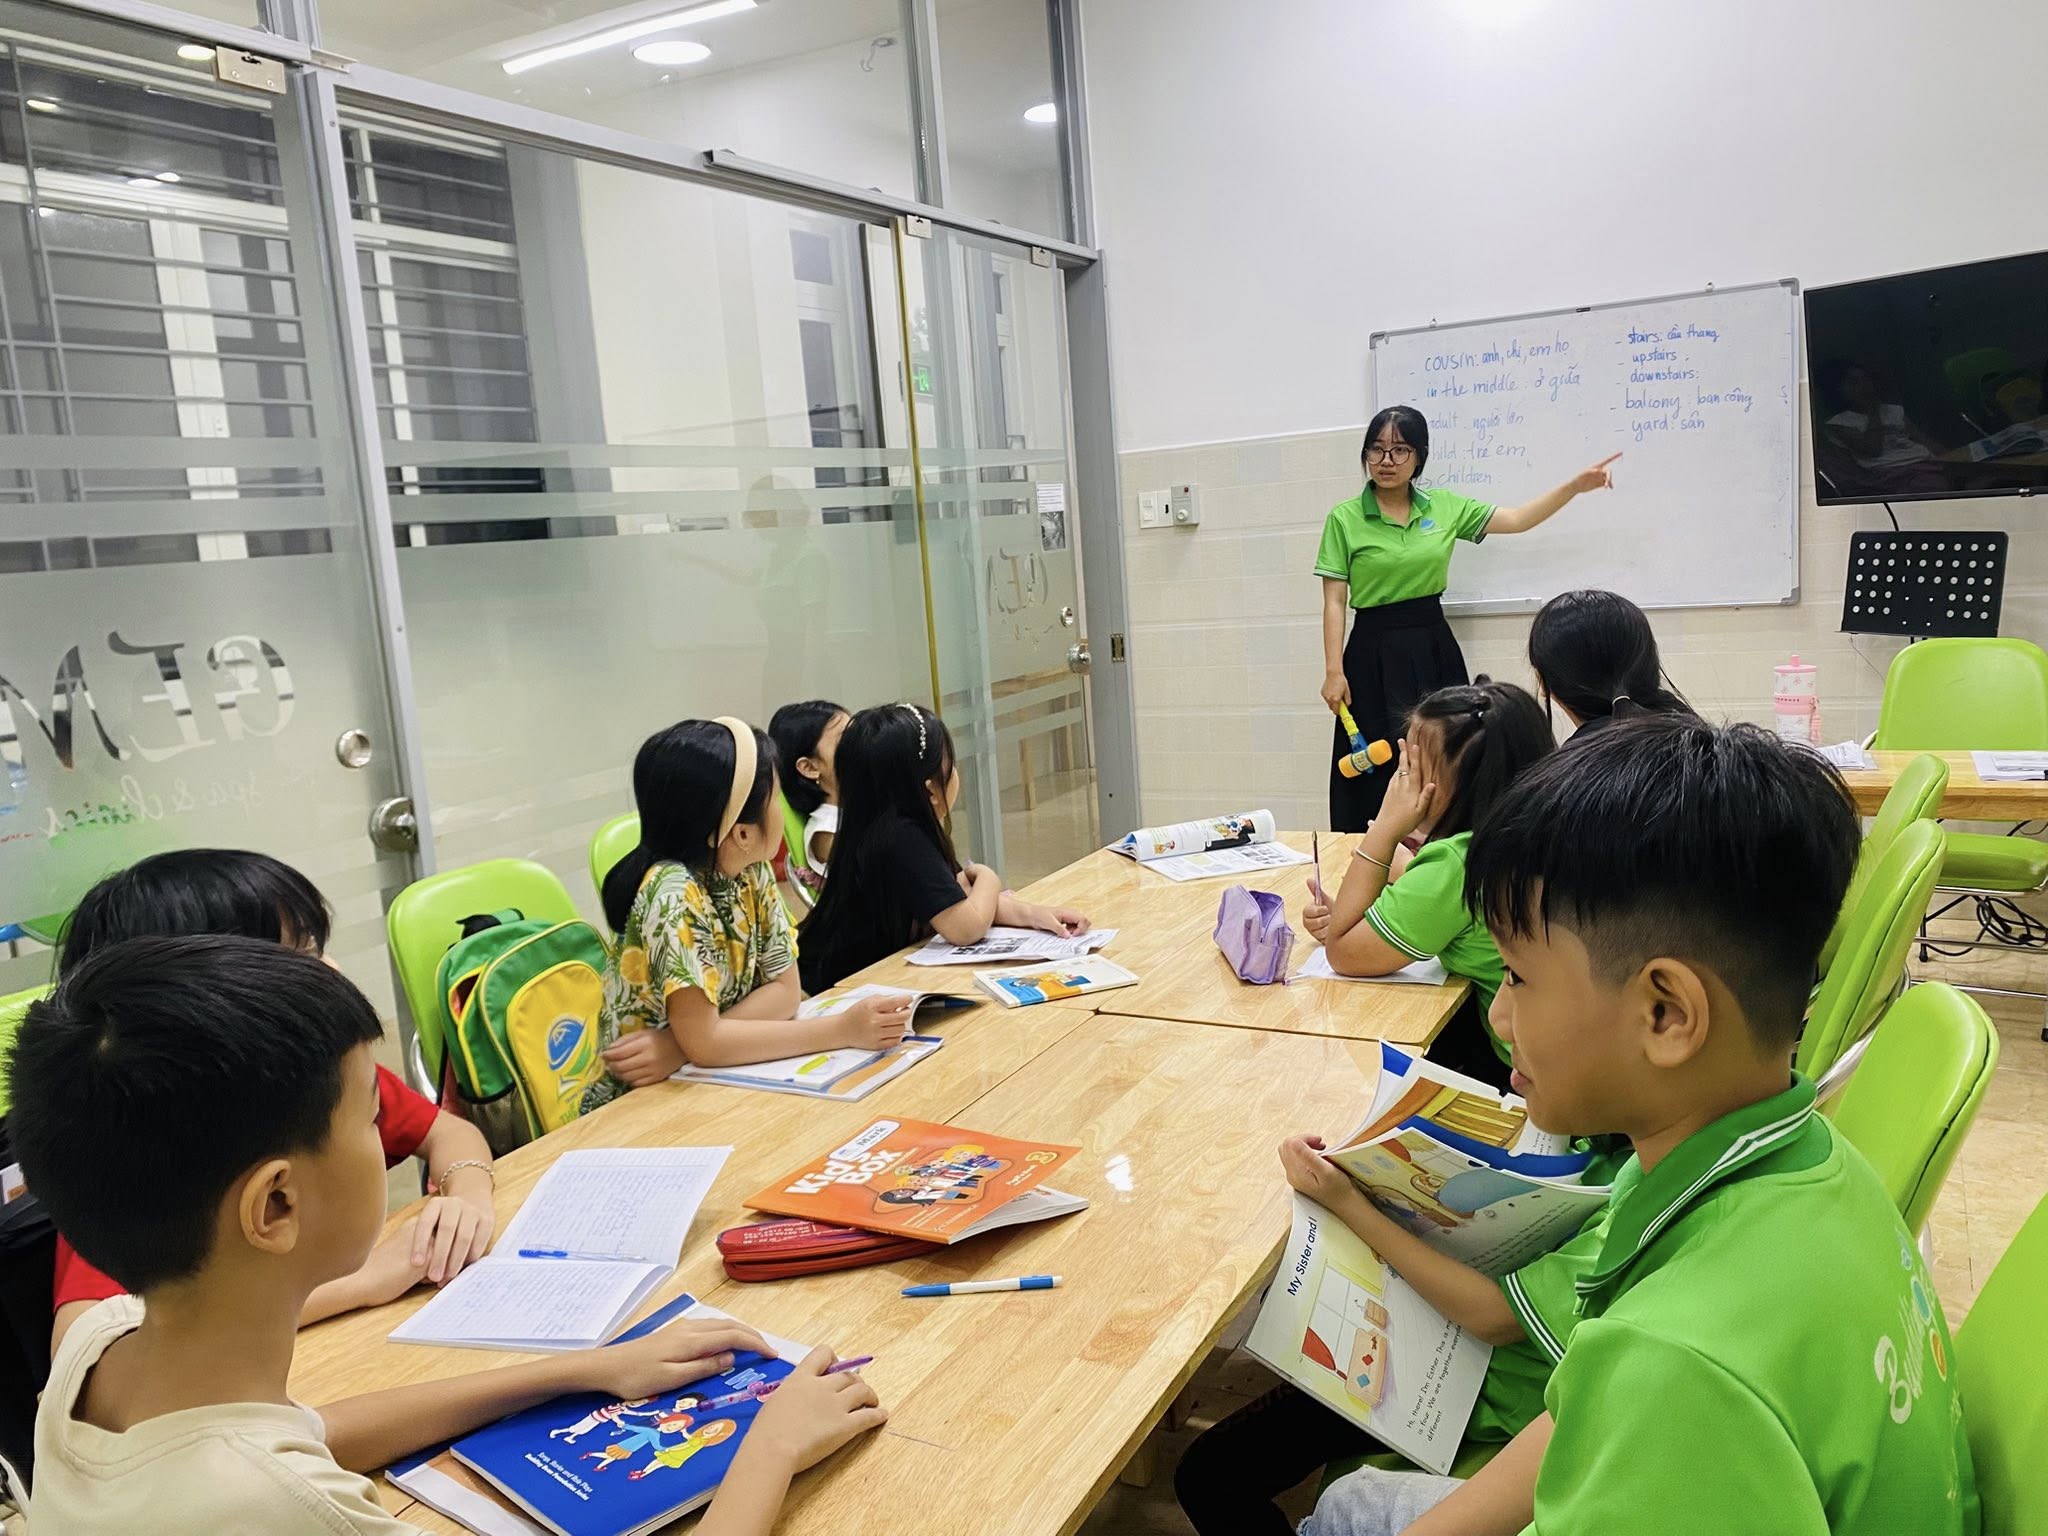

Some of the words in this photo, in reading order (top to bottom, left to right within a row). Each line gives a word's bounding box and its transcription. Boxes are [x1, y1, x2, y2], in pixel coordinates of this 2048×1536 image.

[1529, 345, 1551, 357] em
[1427, 382, 1438, 398] in
[1440, 375, 1468, 397] the
[1697, 385, 1721, 406] ban
[1495, 444, 1526, 457] em
[1287, 1276, 1303, 1296] My
[1295, 1244, 1313, 1275] Sister
[1307, 1221, 1317, 1243] and
[1426, 1396, 1437, 1409] We
[1434, 1382, 1442, 1395] are
[1439, 1352, 1454, 1381] together
